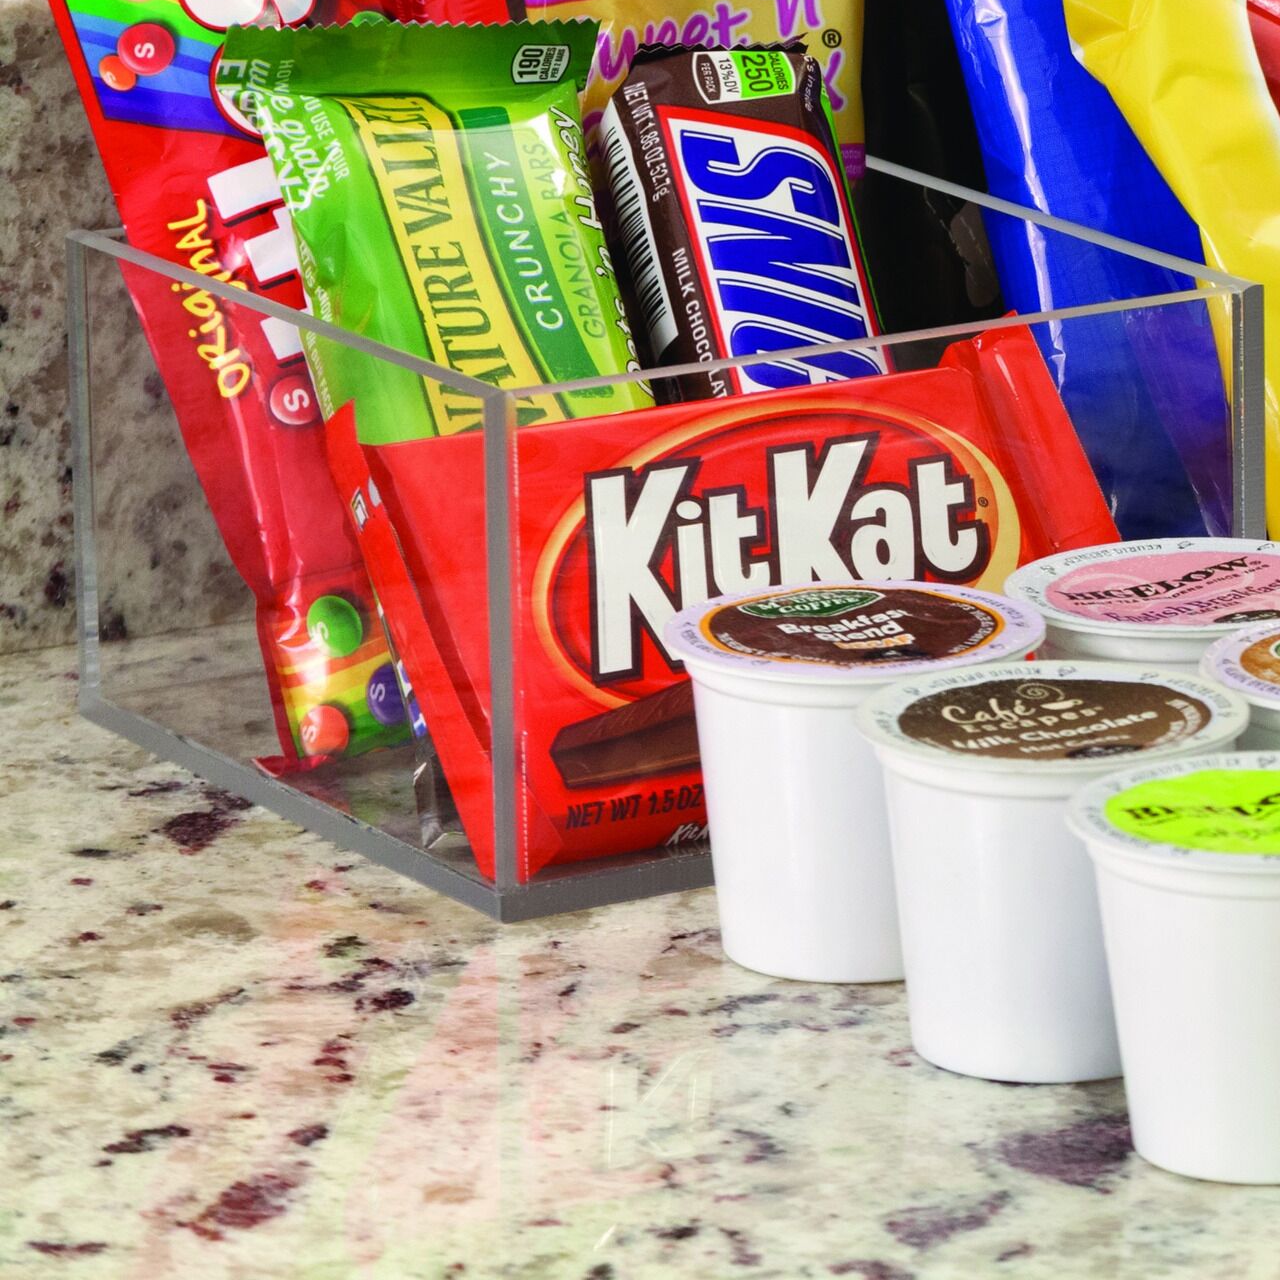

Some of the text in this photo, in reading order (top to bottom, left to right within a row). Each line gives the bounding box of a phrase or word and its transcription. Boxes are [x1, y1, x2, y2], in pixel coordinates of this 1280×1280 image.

[518, 48, 544, 79] 190
[538, 47, 557, 81] CALORIES
[740, 53, 775, 93] 250
[767, 51, 789, 91] CALORIES
[310, 111, 335, 141] USE
[324, 137, 351, 183] YOUR
[623, 81, 672, 203] NET WT 1.86 OZ 52.7g
[483, 151, 565, 331] CRUNCHY
[522, 142, 605, 340] GRANOLA BARS
[672, 247, 697, 299] MILK
[776, 608, 914, 634] Breakfast
[778, 594, 863, 614] COFFEE
[814, 620, 905, 642] Blend
[941, 697, 1037, 726] Café
[961, 707, 1097, 734] Escapes
[1018, 710, 1159, 741] Chocolate
[566, 800, 606, 831] NET
[610, 794, 643, 822] WT
[647, 789, 675, 816] 1.5
